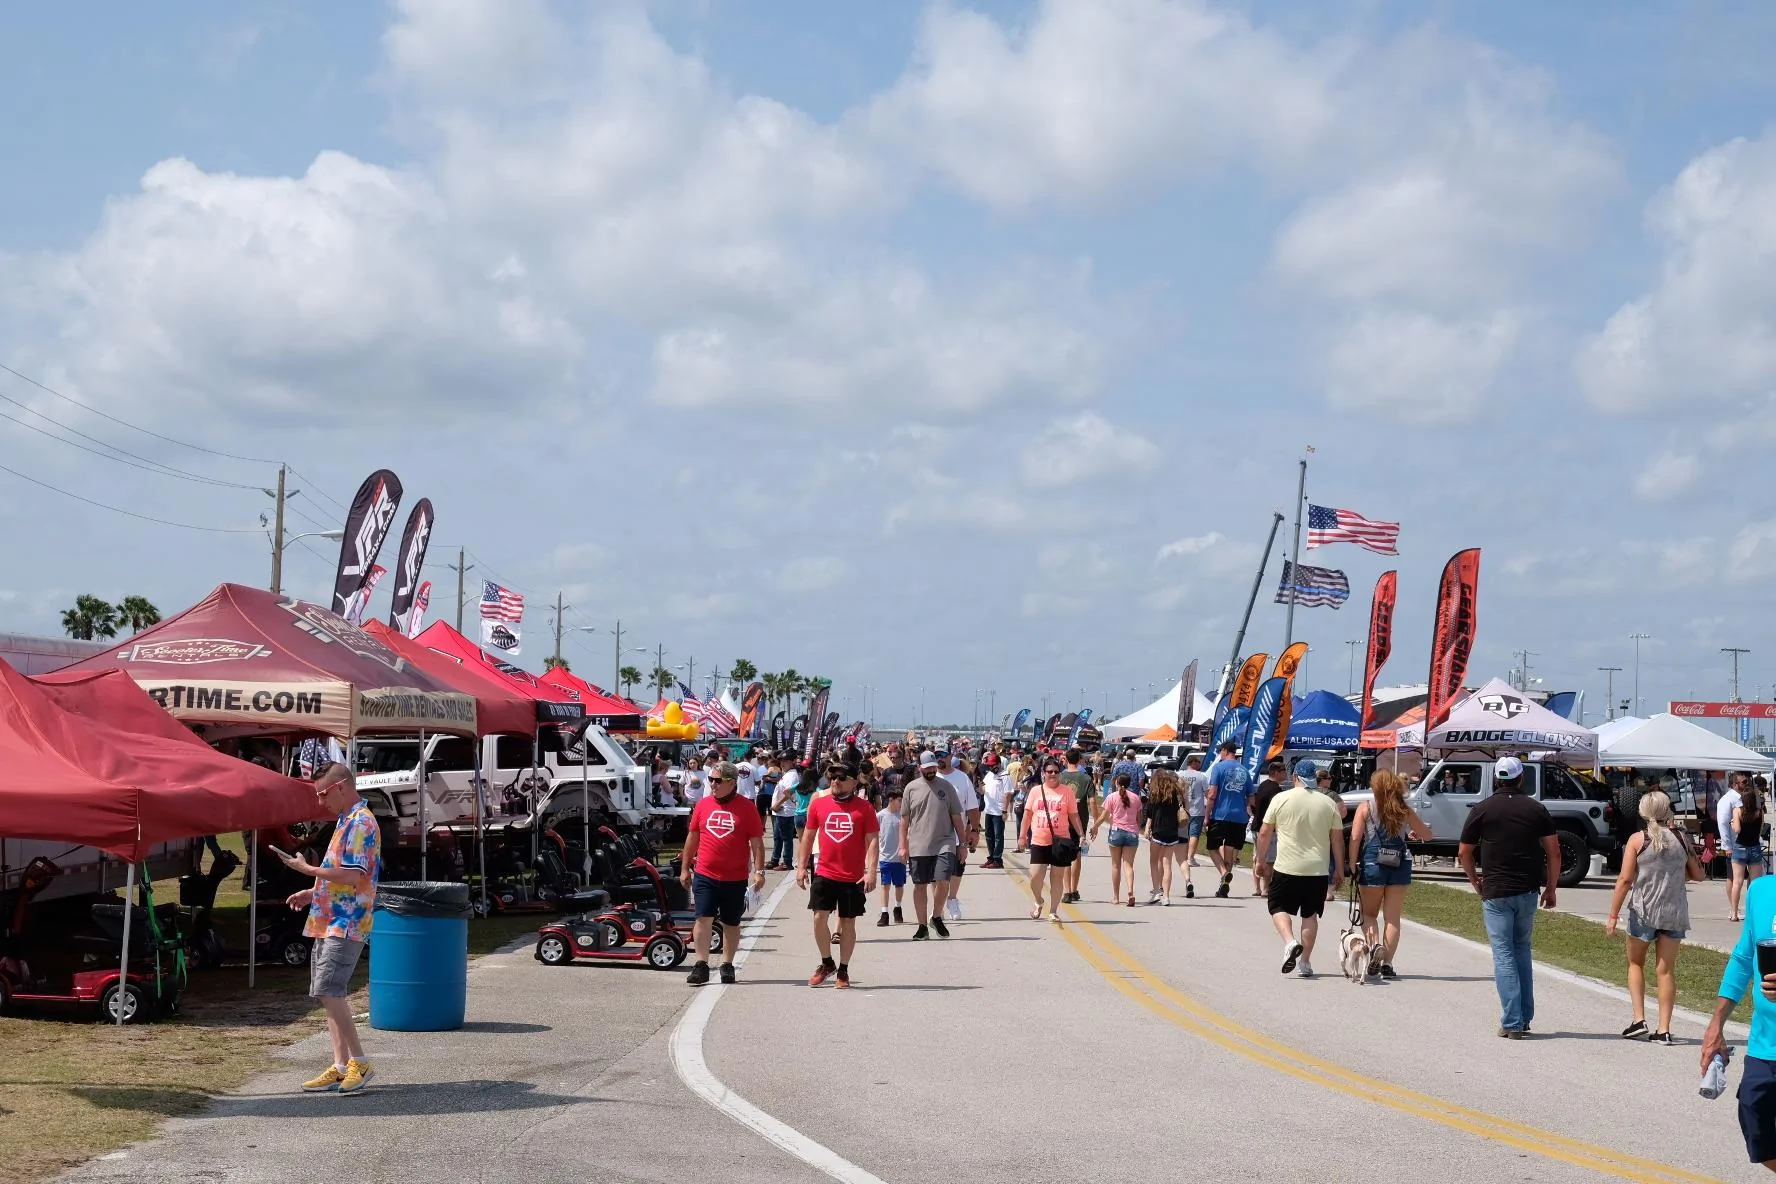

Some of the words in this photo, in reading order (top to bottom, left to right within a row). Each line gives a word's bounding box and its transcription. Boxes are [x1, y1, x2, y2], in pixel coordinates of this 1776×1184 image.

[359, 694, 397, 718] SCOOTER
[397, 695, 416, 718] TIME
[1674, 703, 1707, 716] Coca-Cola
[1719, 704, 1752, 716] Coca-Cola
[1314, 717, 1359, 727] ALPINE
[1290, 736, 1359, 746] ALPINE-USA.CO
[1445, 730, 1515, 743] BADGE
[1516, 730, 1585, 748] GLOW
[370, 777, 391, 785] VAULT
